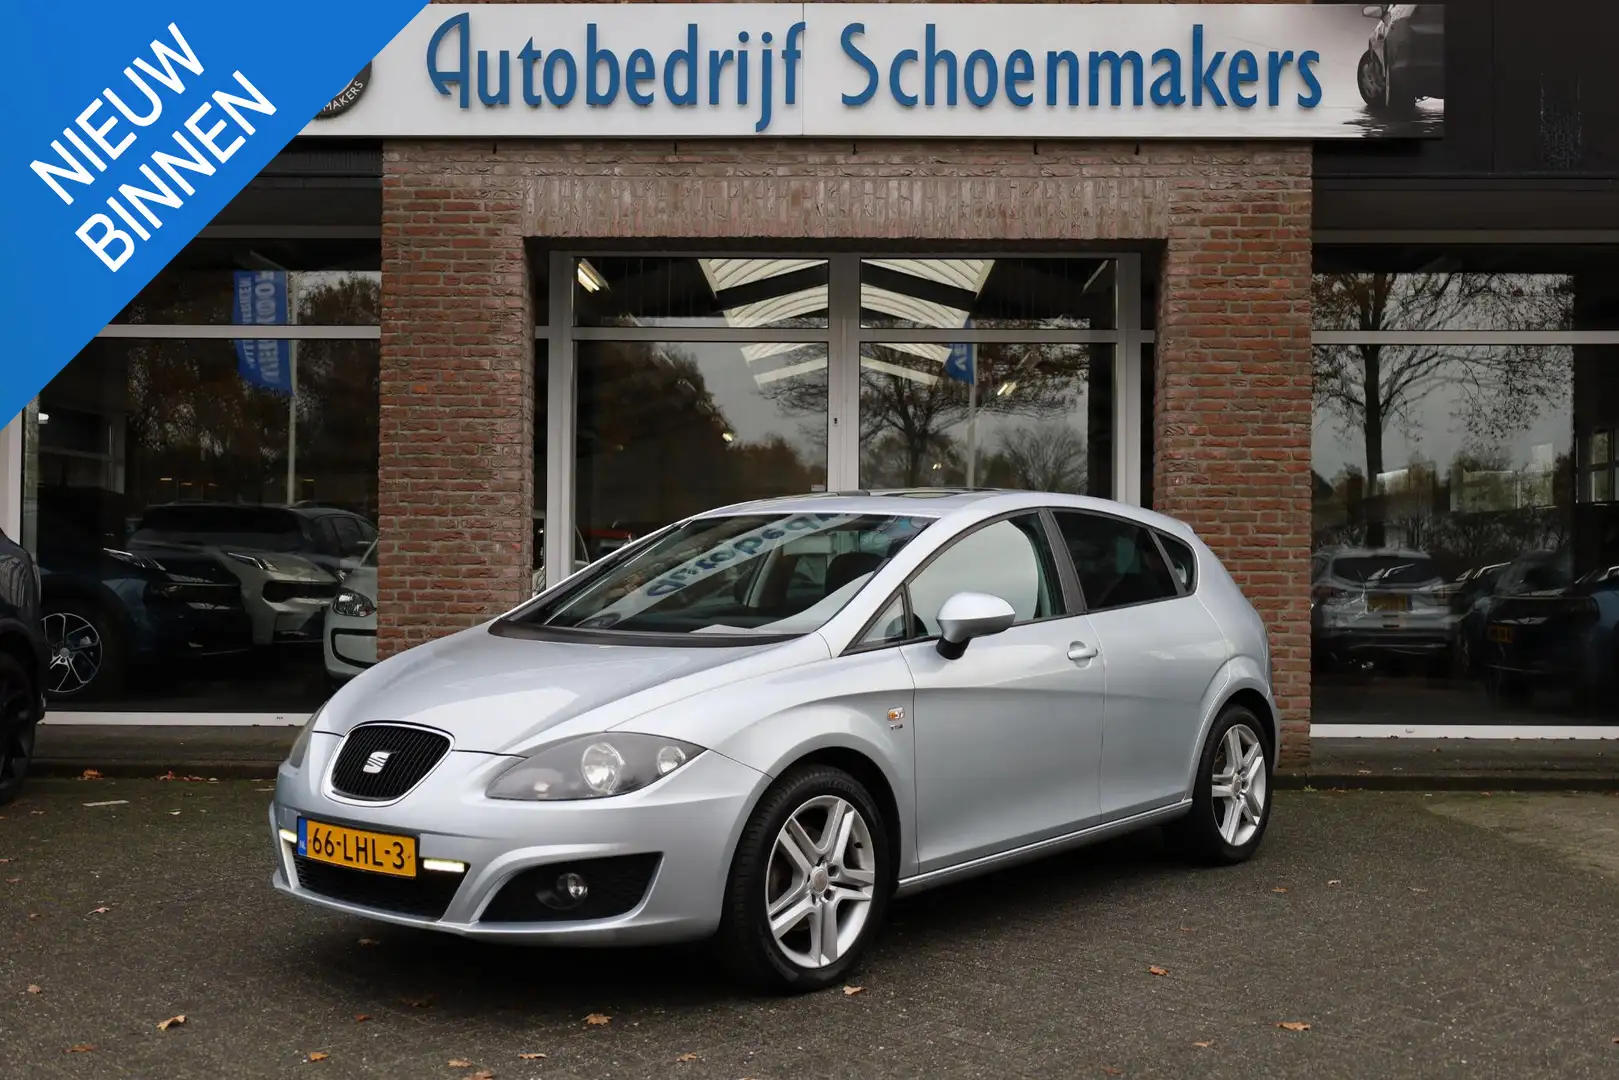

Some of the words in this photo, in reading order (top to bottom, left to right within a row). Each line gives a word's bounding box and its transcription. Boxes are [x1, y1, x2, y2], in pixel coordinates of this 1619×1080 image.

[426, 12, 806, 133] Autobedrijf
[840, 22, 1323, 108] Schoenmakers
[311, 828, 405, 870] 66-LHL-3
